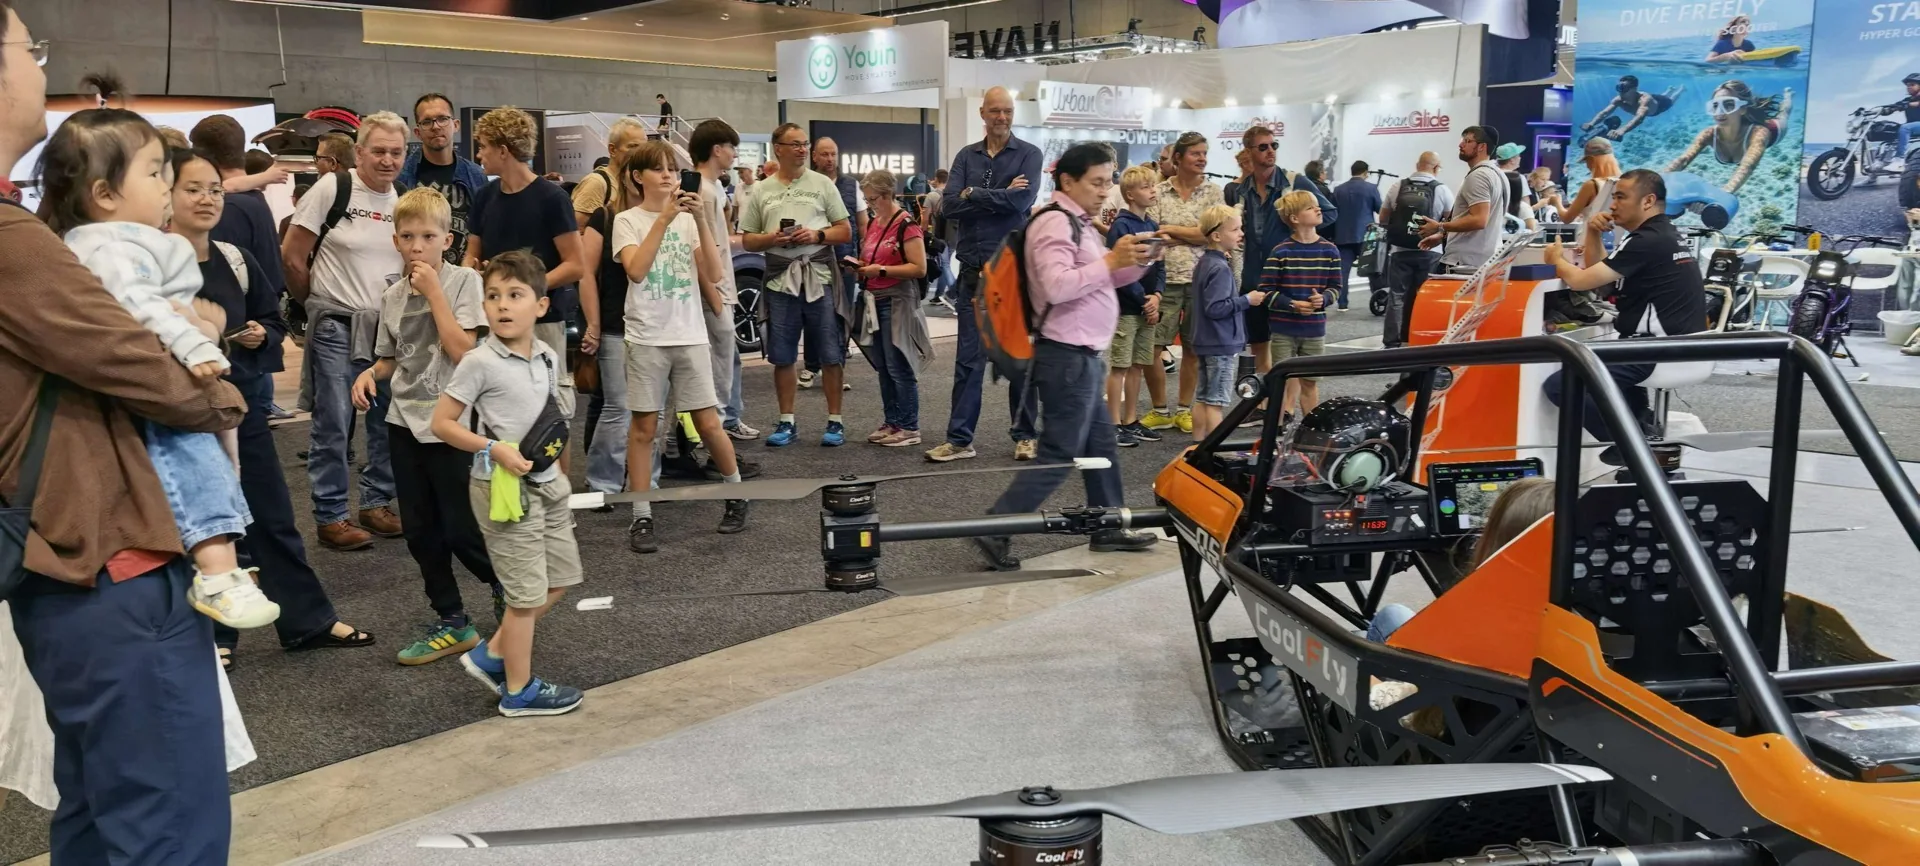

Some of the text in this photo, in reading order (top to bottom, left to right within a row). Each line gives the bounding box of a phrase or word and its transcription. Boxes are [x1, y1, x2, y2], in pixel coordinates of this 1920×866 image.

[1620, 0, 1767, 27] DIVE FREELY
[1860, 28, 1901, 40] HYPER
[843, 44, 896, 69] Youin
[845, 70, 896, 82] MOVE SMARTER
[1052, 86, 1144, 119] UrbanGlide
[1374, 109, 1450, 128] UrbanGlide
[1120, 130, 1168, 144] POWER
[1221, 140, 1233, 150] 10
[842, 153, 915, 174] NAVEE
[348, 207, 373, 219] JACK
[1255, 602, 1347, 696] CoolFly
[1036, 848, 1085, 863] CoolFly
